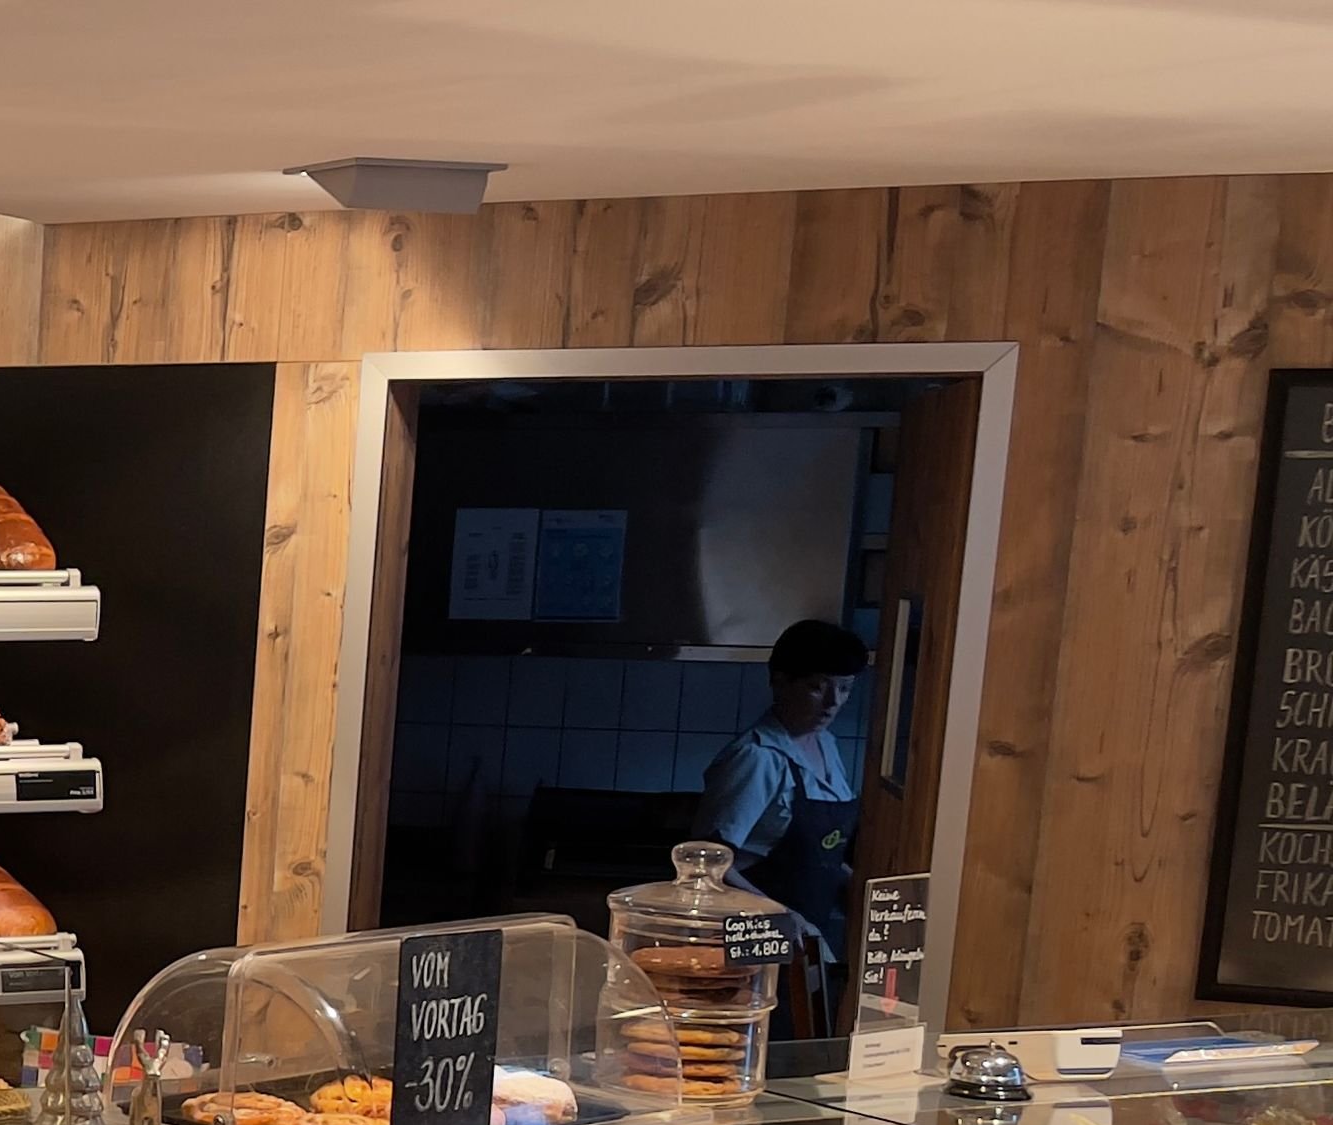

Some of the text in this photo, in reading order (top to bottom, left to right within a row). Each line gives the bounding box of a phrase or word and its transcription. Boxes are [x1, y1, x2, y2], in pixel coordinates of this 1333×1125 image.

[411, 951, 451, 989] VOM
[411, 994, 487, 1041] VORTAG
[405, 1052, 475, 1112] -30%
